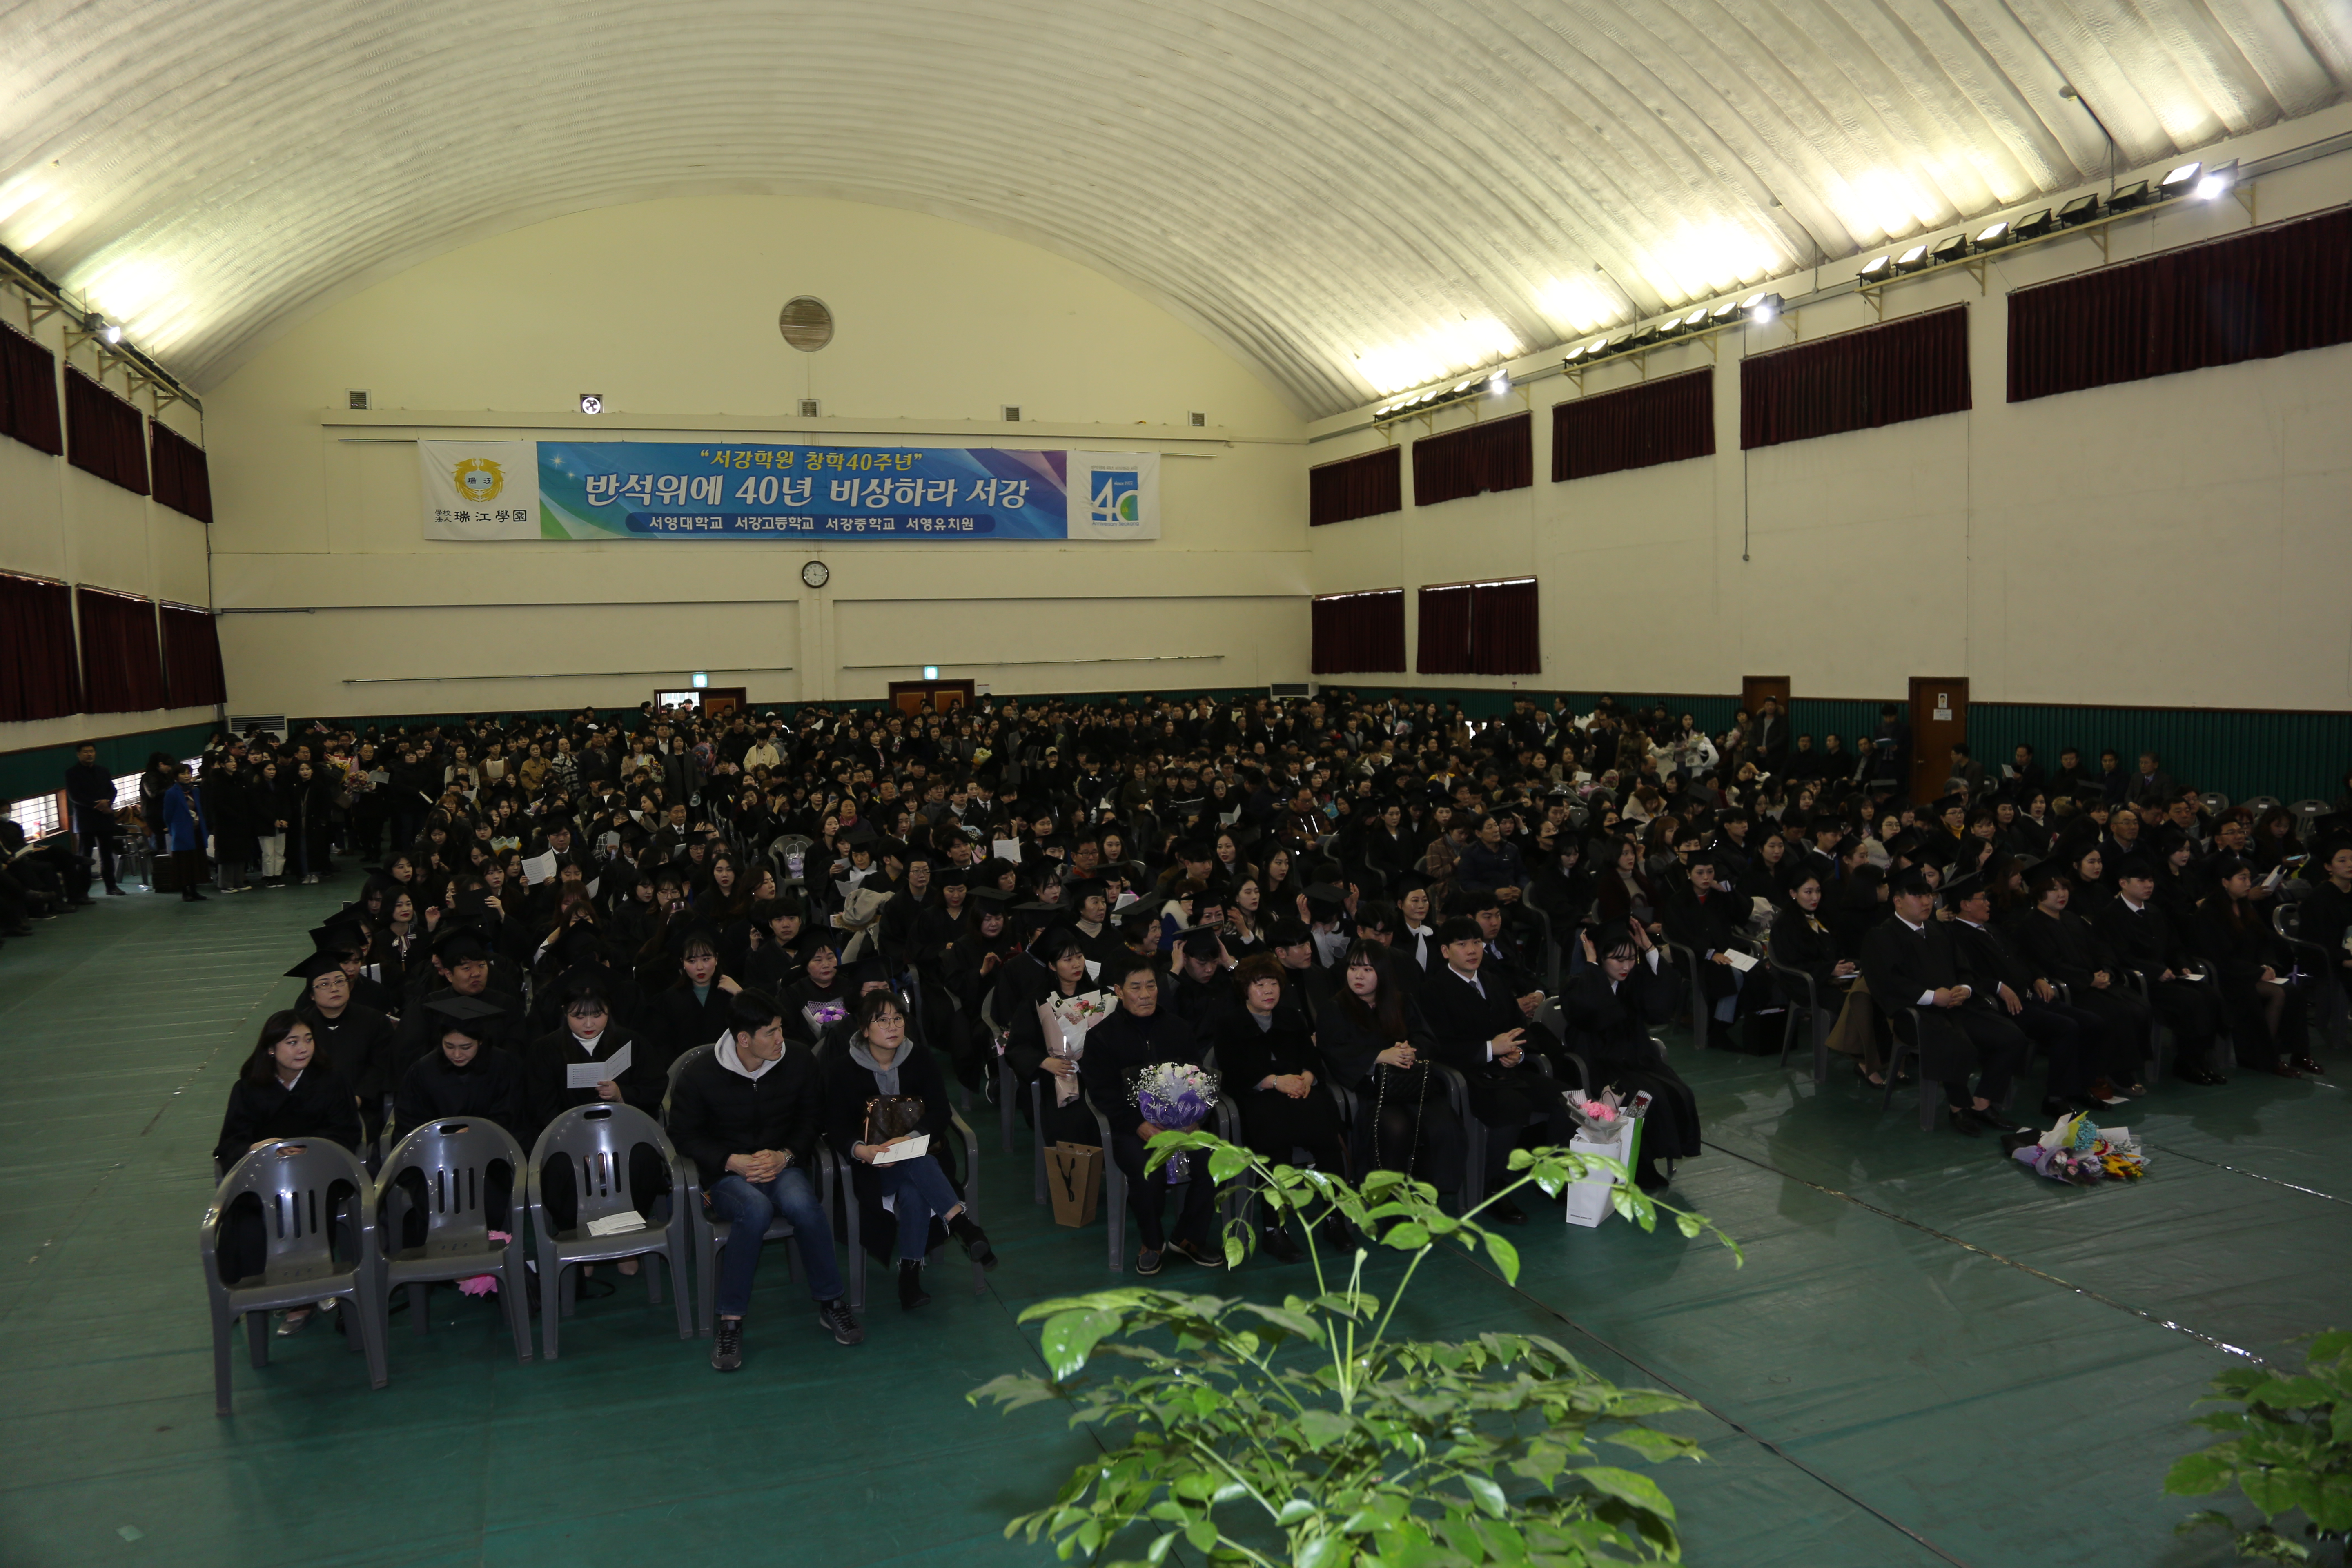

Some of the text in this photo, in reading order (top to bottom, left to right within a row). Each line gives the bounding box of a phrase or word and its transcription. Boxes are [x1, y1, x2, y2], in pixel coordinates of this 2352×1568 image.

[700, 449, 922, 472] “서강학원 창학40주년”
[586, 474, 1030, 509] 반석위에 40년 비상하라 서강
[649, 516, 974, 532] 서영대학교 서강고등학교 서강중학교 서영유치원
